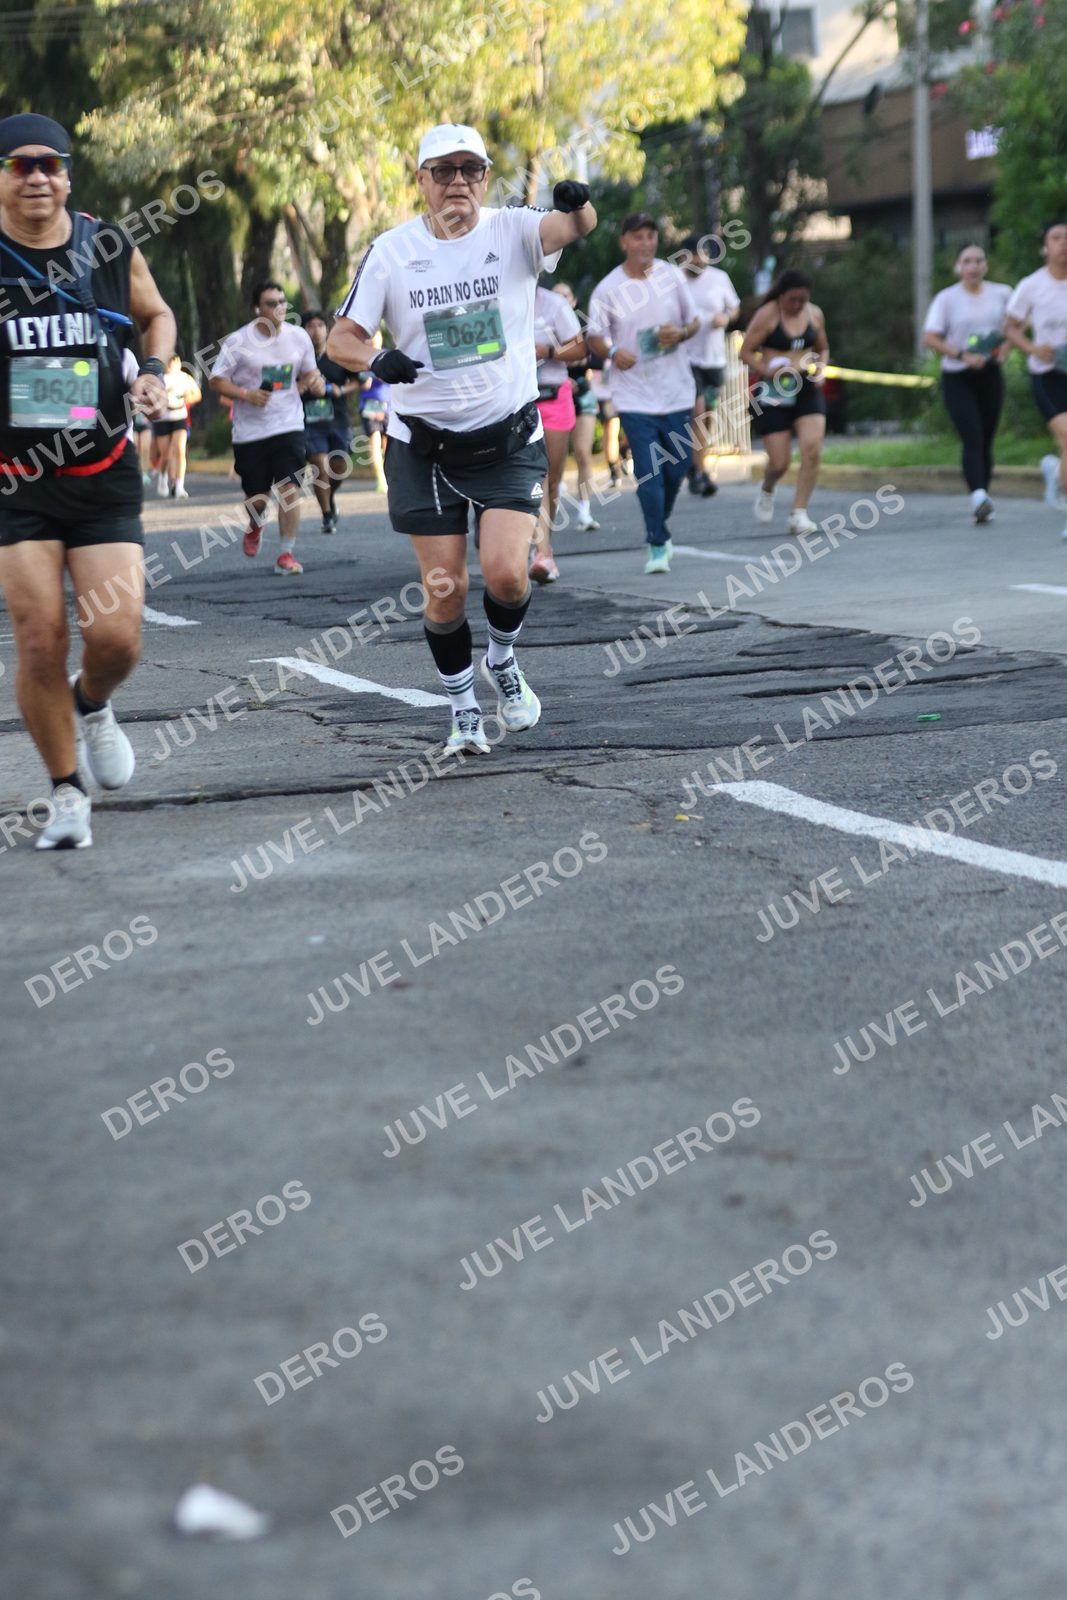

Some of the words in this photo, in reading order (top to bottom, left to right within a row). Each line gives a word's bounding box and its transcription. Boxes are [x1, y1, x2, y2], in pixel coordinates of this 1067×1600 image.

[409, 291, 424, 308] NO
[427, 284, 452, 306] PAIN
[454, 281, 470, 301] NO
[473, 275, 499, 297] GAIN
[446, 316, 501, 348] 0621
[32, 377, 95, 405] 0620
